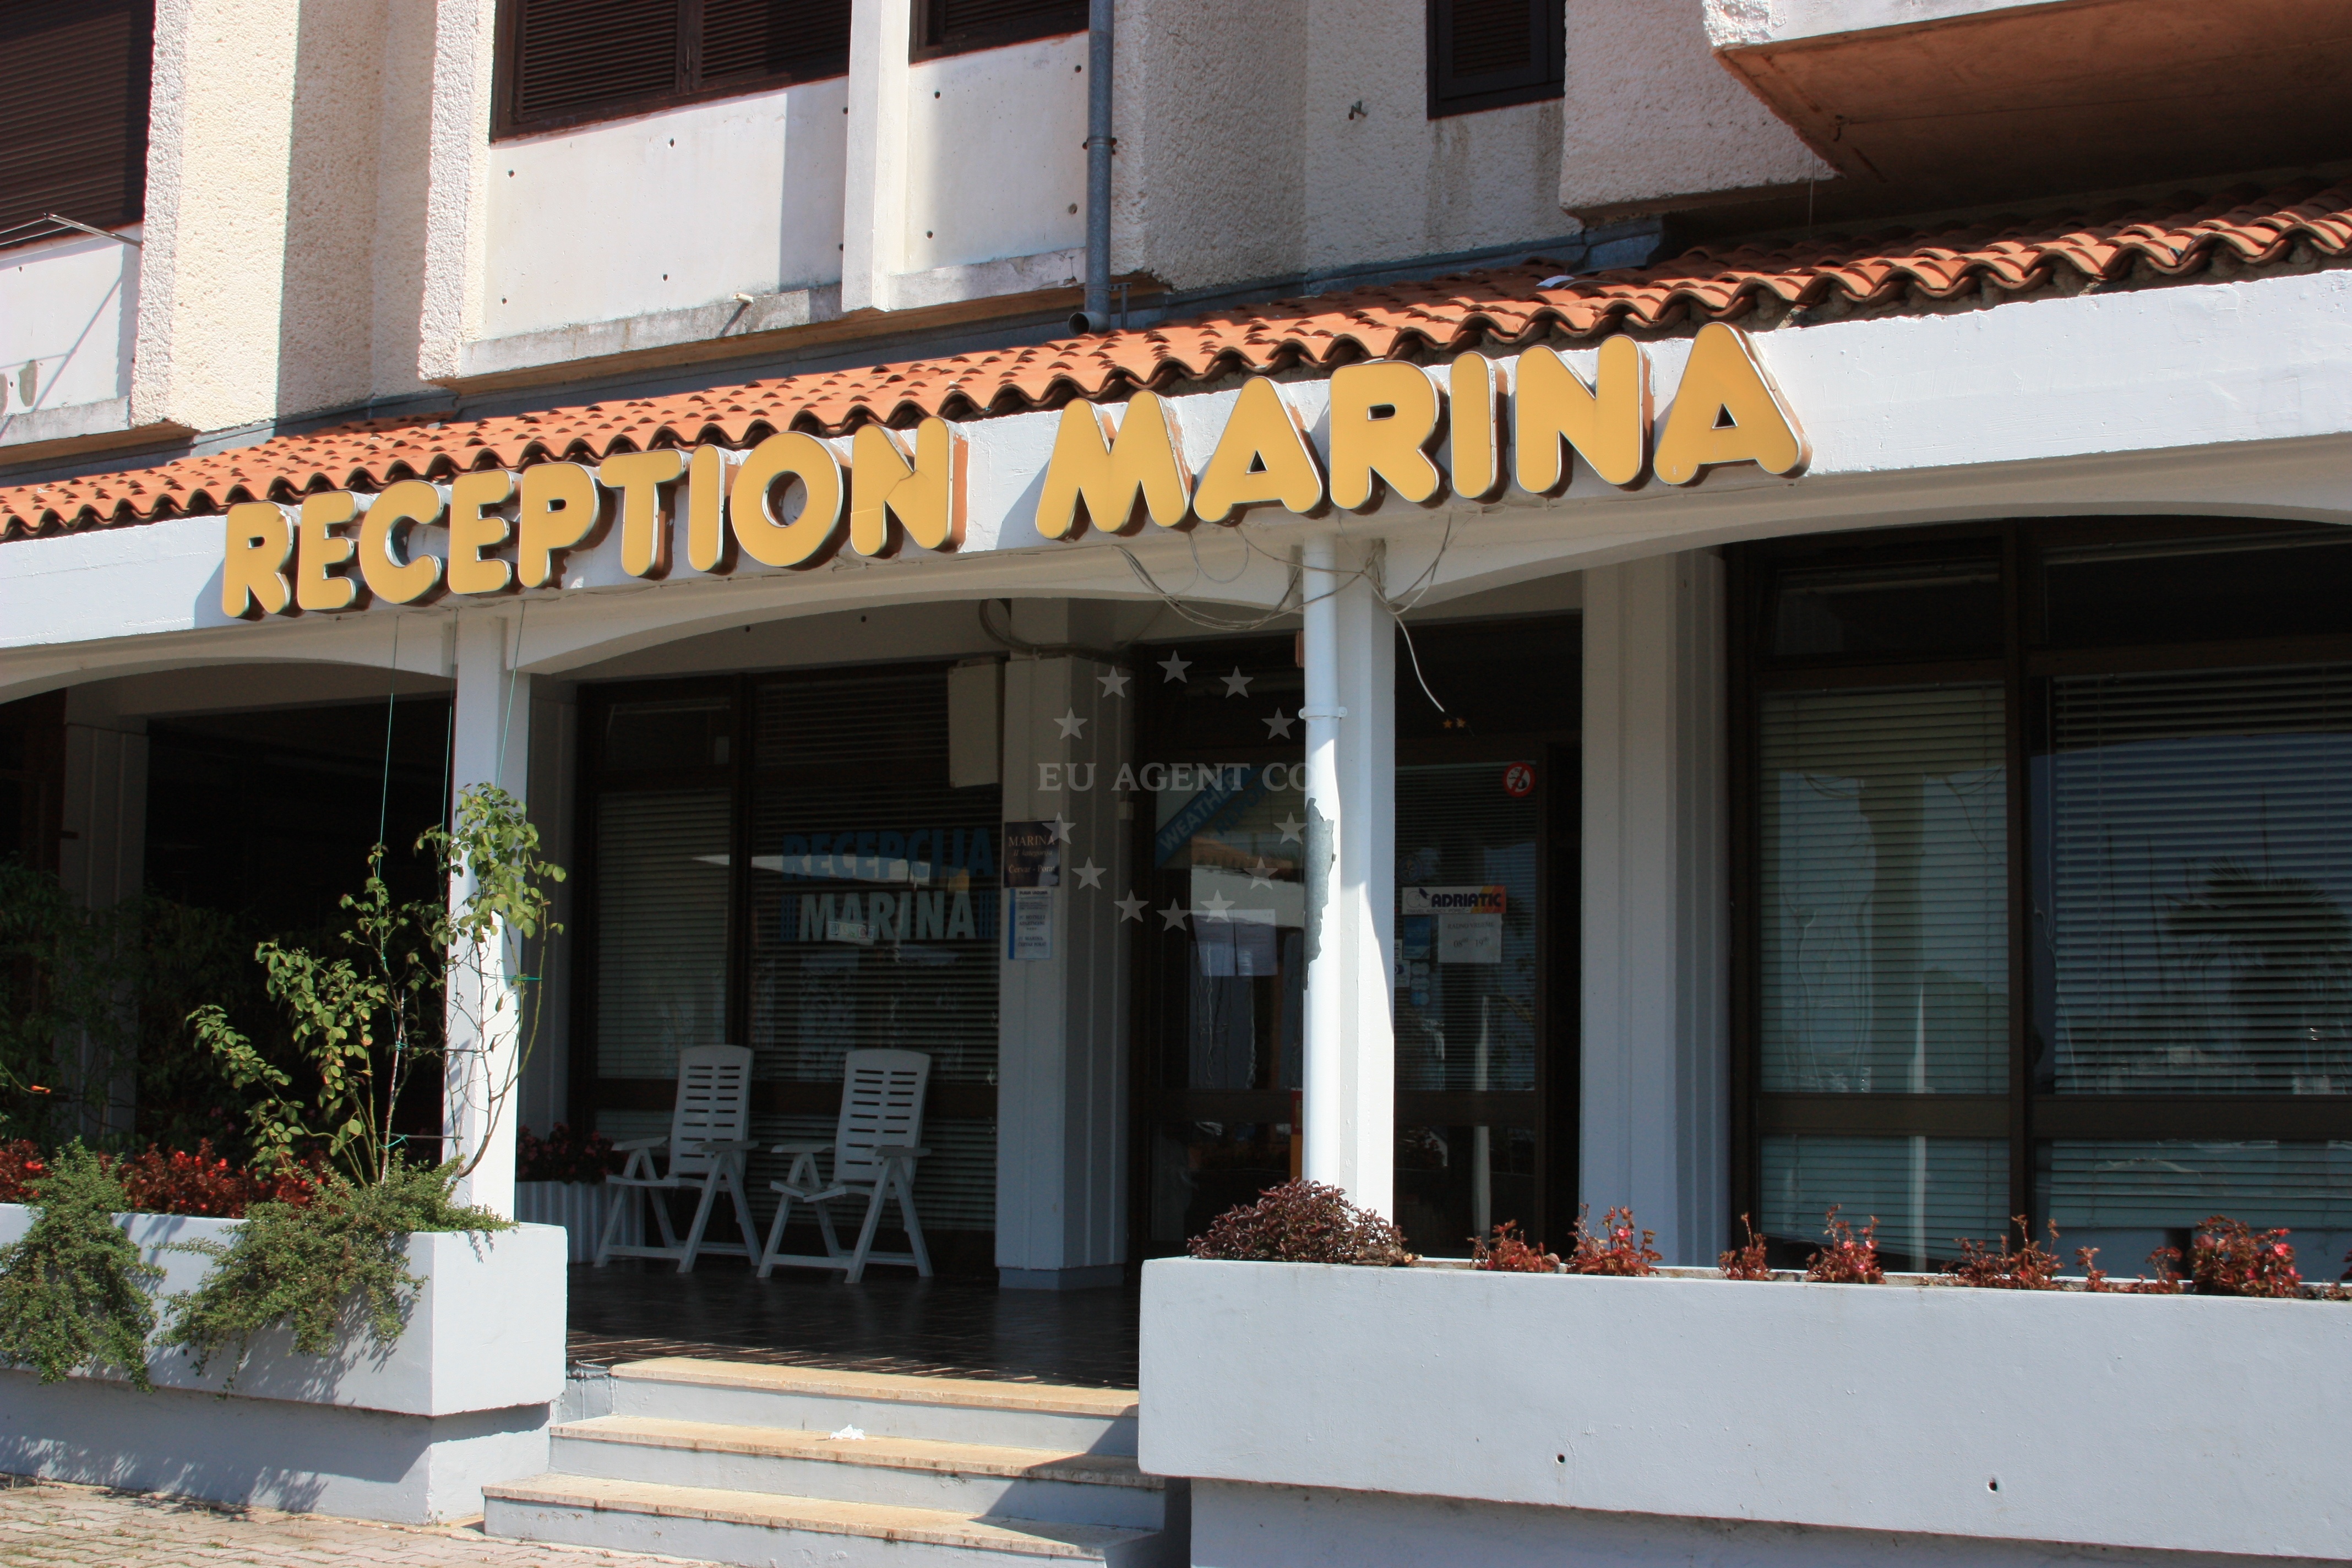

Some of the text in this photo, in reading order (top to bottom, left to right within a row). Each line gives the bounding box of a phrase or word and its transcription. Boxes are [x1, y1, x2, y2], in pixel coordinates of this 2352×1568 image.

[222, 322, 1807, 618] RECEPTION MARINA
[1159, 772, 1237, 851] WEATHER
[781, 827, 995, 882] RECEPCIJA
[1009, 835, 1055, 847] MARINA
[1009, 864, 1031, 874] Červar
[1038, 864, 1055, 873] Porat
[798, 890, 977, 942] MARINA
[1431, 893, 1501, 908] ADRIATIC
